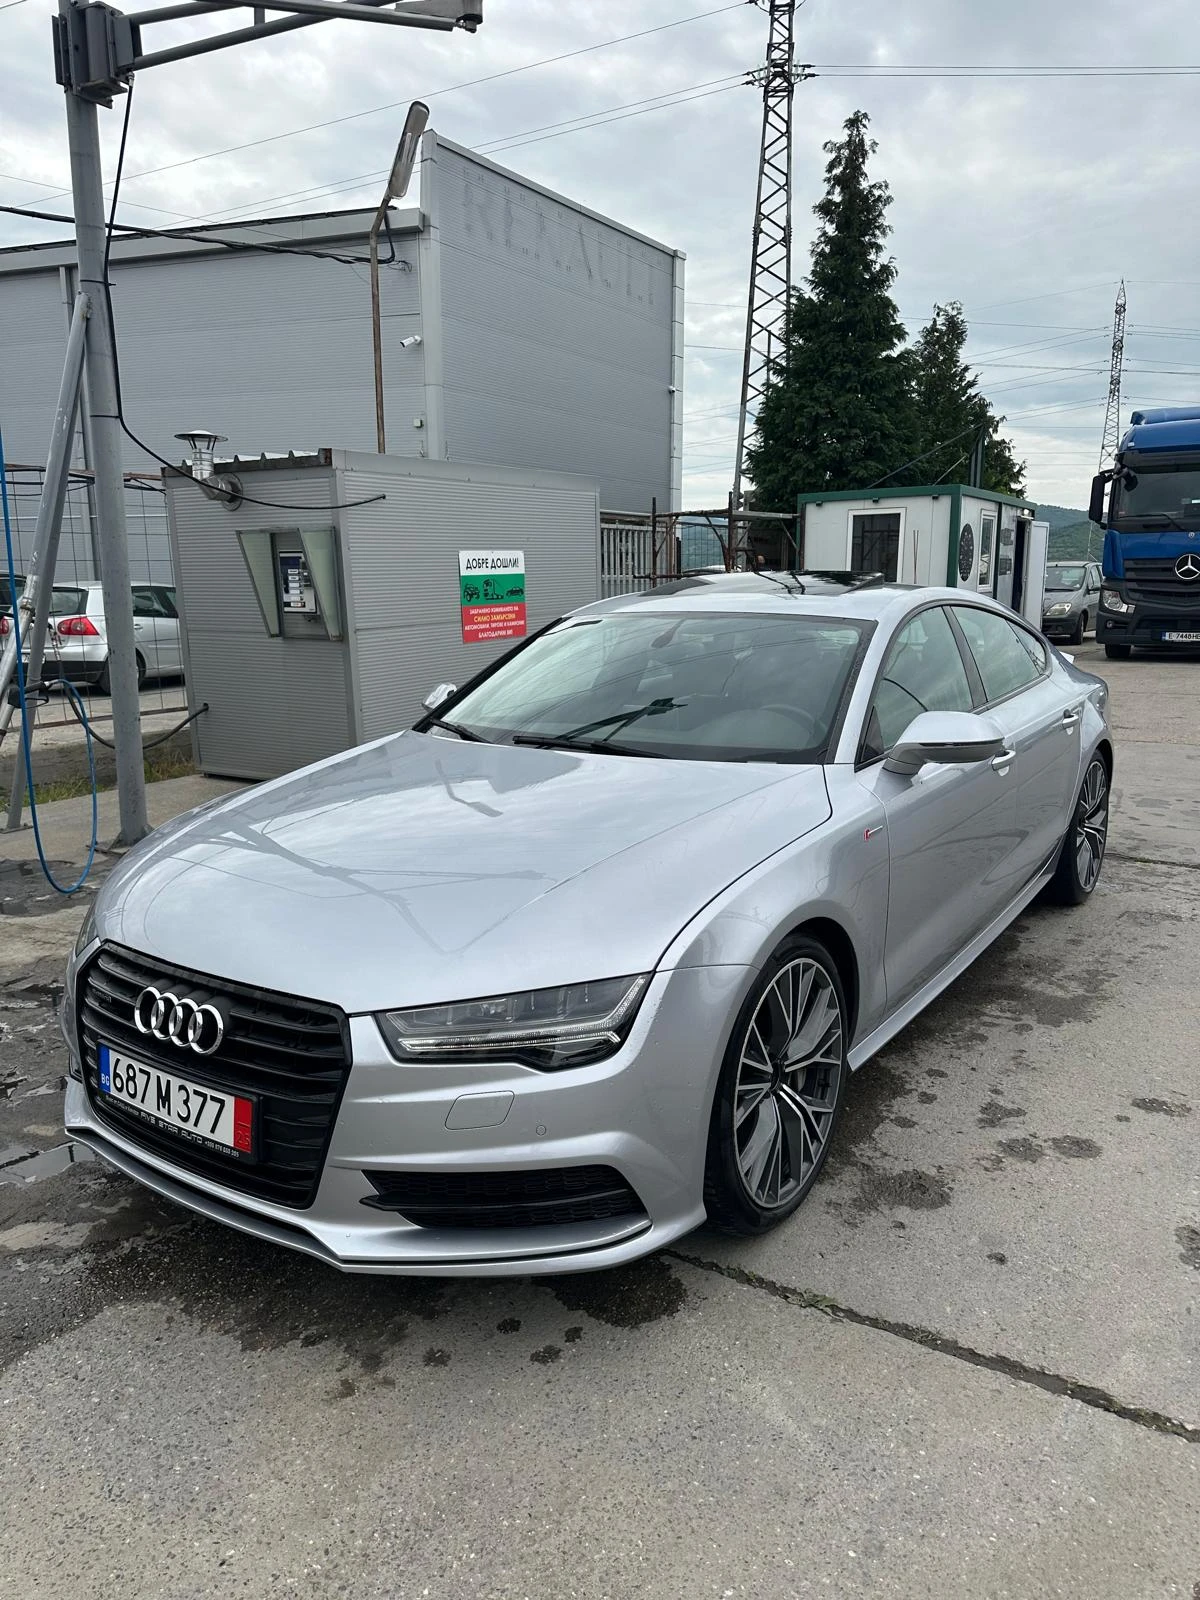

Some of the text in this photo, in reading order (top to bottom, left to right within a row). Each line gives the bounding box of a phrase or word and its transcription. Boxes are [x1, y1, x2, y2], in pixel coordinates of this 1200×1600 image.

[466, 557, 519, 570] ДОБРЕ ДОШЛИ!
[474, 614, 490, 622] СИЛНО
[478, 630, 506, 639] БЛАГОДАРИМ
[101, 1073, 110, 1087] BG
[112, 1057, 152, 1104] 687
[156, 1074, 172, 1117] M
[176, 1084, 226, 1135] 377
[140, 1111, 156, 1124] FIVE
[158, 1120, 179, 1135] STAR
[181, 1129, 203, 1144] AUTO
